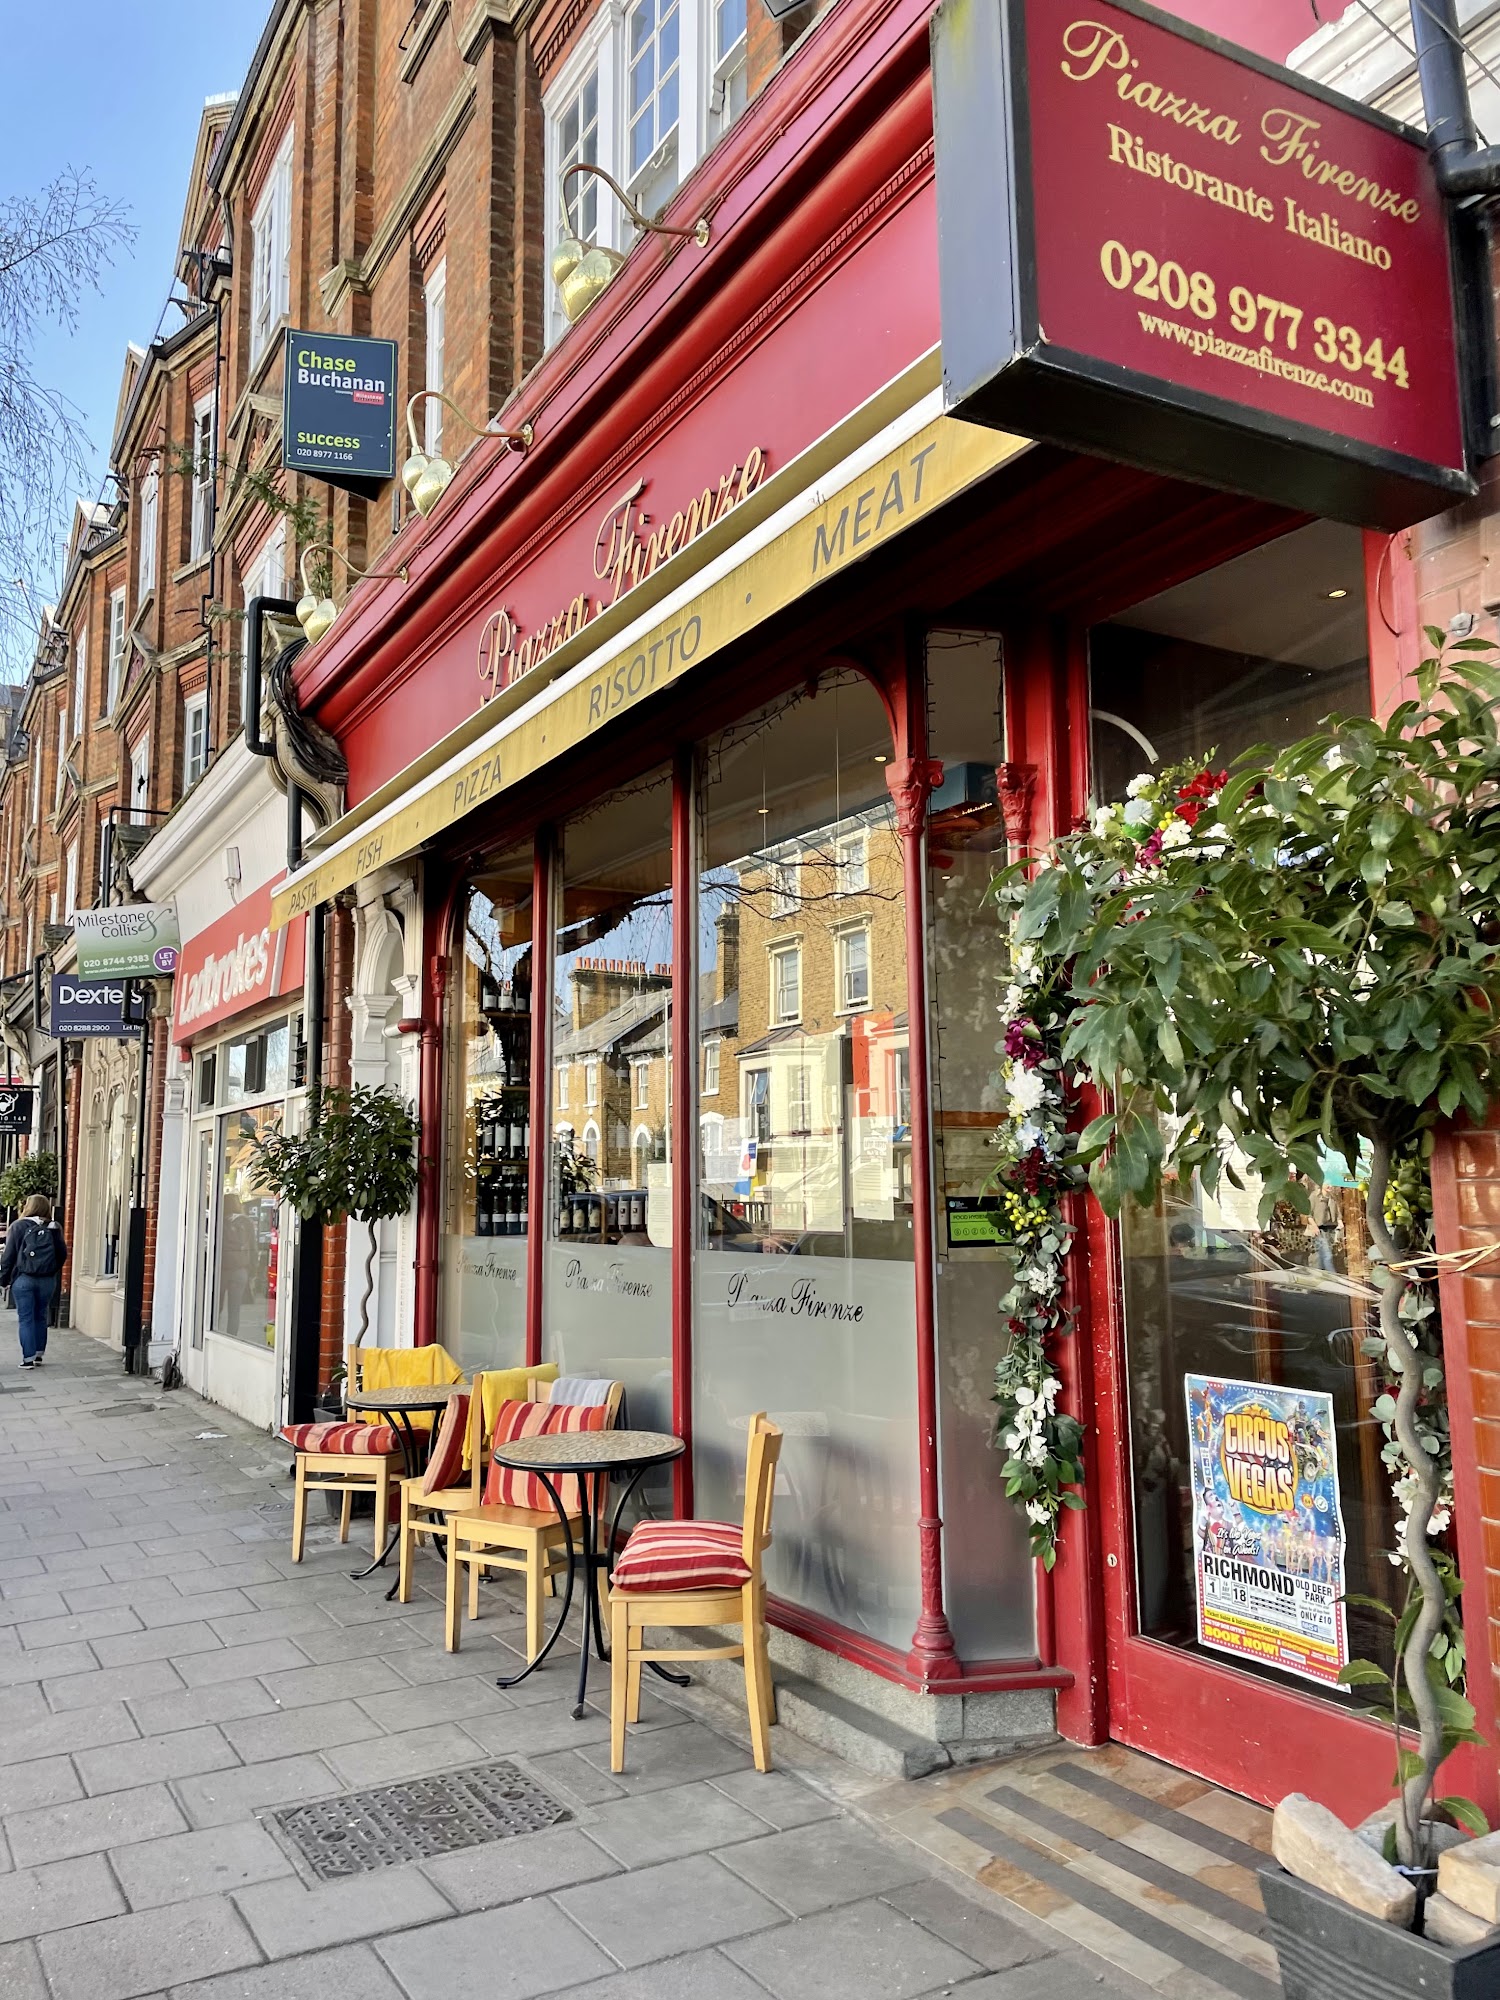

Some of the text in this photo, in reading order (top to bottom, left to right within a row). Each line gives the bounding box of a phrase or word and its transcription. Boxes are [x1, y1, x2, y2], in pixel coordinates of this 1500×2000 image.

[1061, 20, 1421, 224] Piazza Firenze
[1107, 124, 1392, 271] Ristorante Italiano
[1100, 240, 1410, 389] 0208 977 3344
[298, 350, 356, 372] Chase
[1138, 309, 1375, 408] www.piazzafirenze.com
[298, 368, 385, 392] Buchanan
[297, 432, 360, 449] success
[296, 448, 353, 460] 020 8977 1166
[477, 446, 766, 708] Piazza Firenze
[288, 442, 937, 916] PASTA FISH PIZZA RISOTTO MEAT
[78, 912, 145, 928] Milestone
[102, 924, 138, 938] Collis
[84, 954, 150, 968] 020 8744 9383
[159, 952, 174, 960] LET
[162, 958, 172, 967] BY
[60, 986, 143, 1005] Dextes
[485, 1252, 517, 1281] Firenze
[790, 1278, 865, 1323] Firenze
[1224, 1412, 1290, 1464] CIRCUS
[1225, 1456, 1296, 1512] VEGAS
[1204, 1554, 1294, 1597] RICHMOND
[1210, 1581, 1215, 1594] 1
[1233, 1588, 1246, 1602] 18
[1296, 1578, 1333, 1597] OLD DEER
[1304, 1591, 1326, 1606] PARK
[1300, 1610, 1332, 1625] ONLY £10
[1204, 1624, 1241, 1645] BOOK
[1242, 1636, 1280, 1657] NOW!
